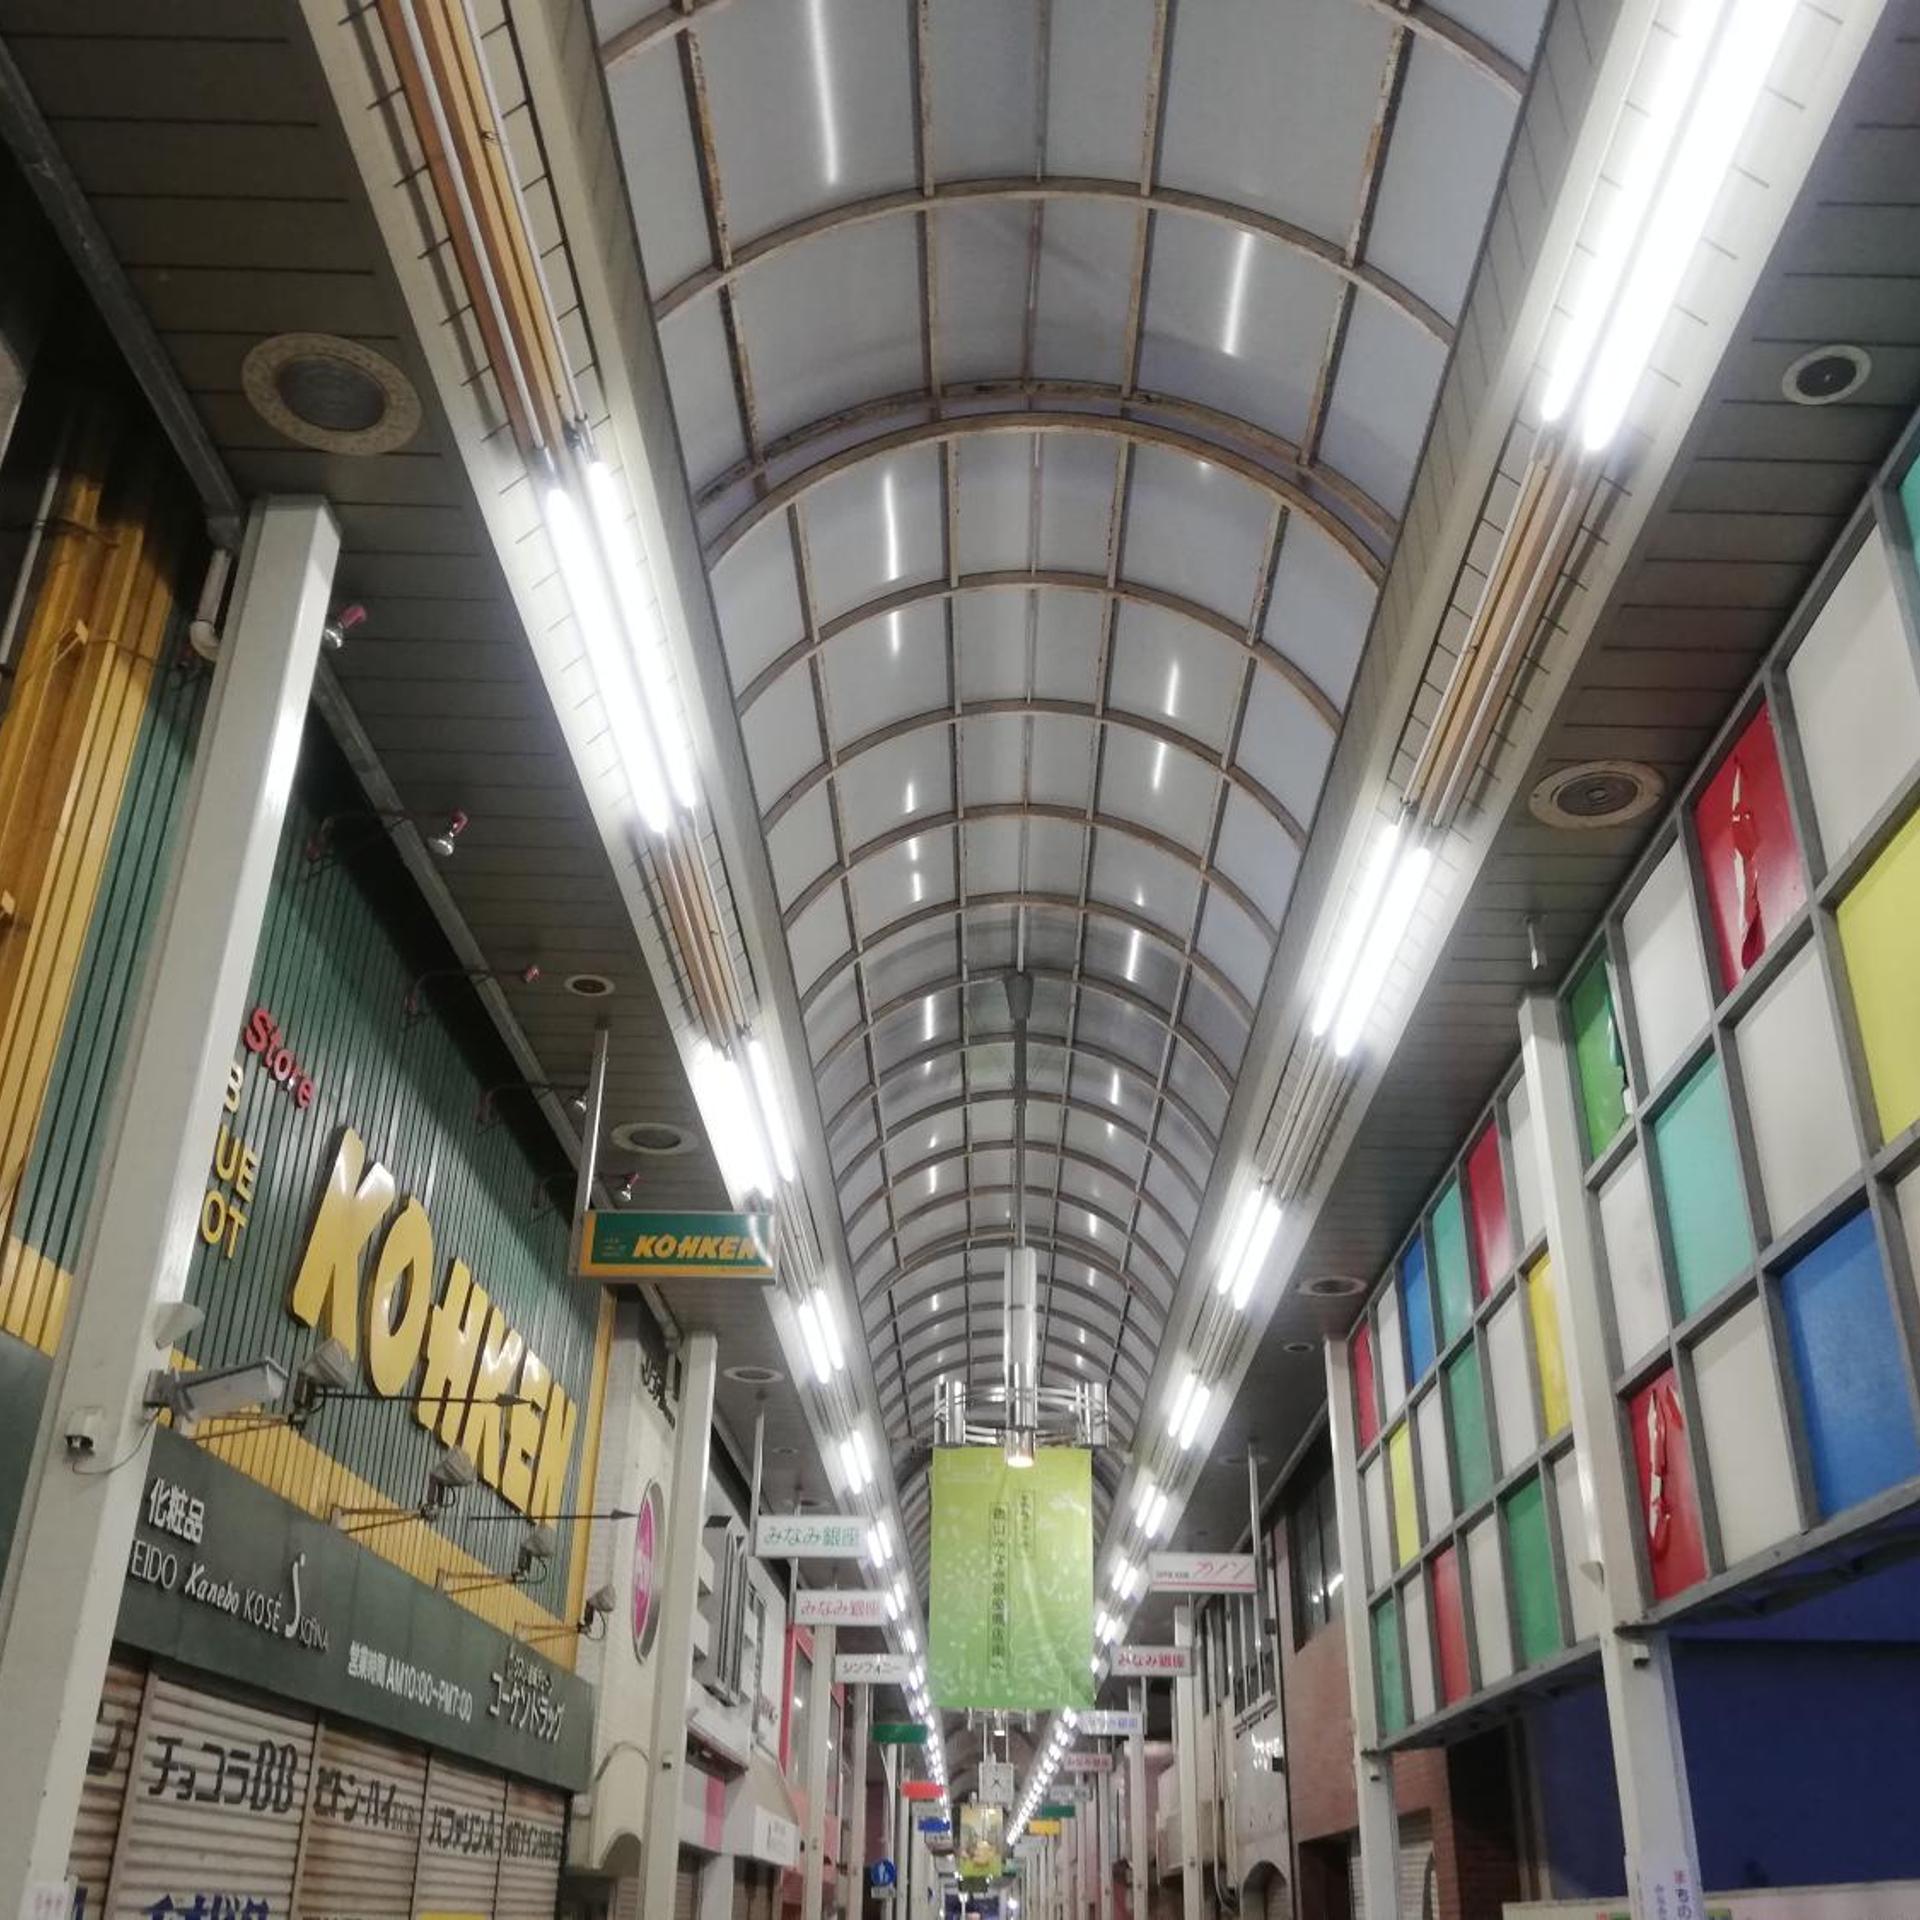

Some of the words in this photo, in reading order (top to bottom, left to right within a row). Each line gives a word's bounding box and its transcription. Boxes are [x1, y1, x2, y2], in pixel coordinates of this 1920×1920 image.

[243, 1008, 314, 1109] Store
[632, 1233, 763, 1259] KOHKEN
[292, 1127, 578, 1528] KOHKEN
[149, 1477, 205, 1544] 化粧品
[765, 1526, 860, 1547] みなみ銀座
[131, 1539, 178, 1589] EIDO
[184, 1561, 240, 1615] Kanebo
[800, 1599, 882, 1617] みなみ銀座
[148, 1736, 298, 1814] チョコラBB
